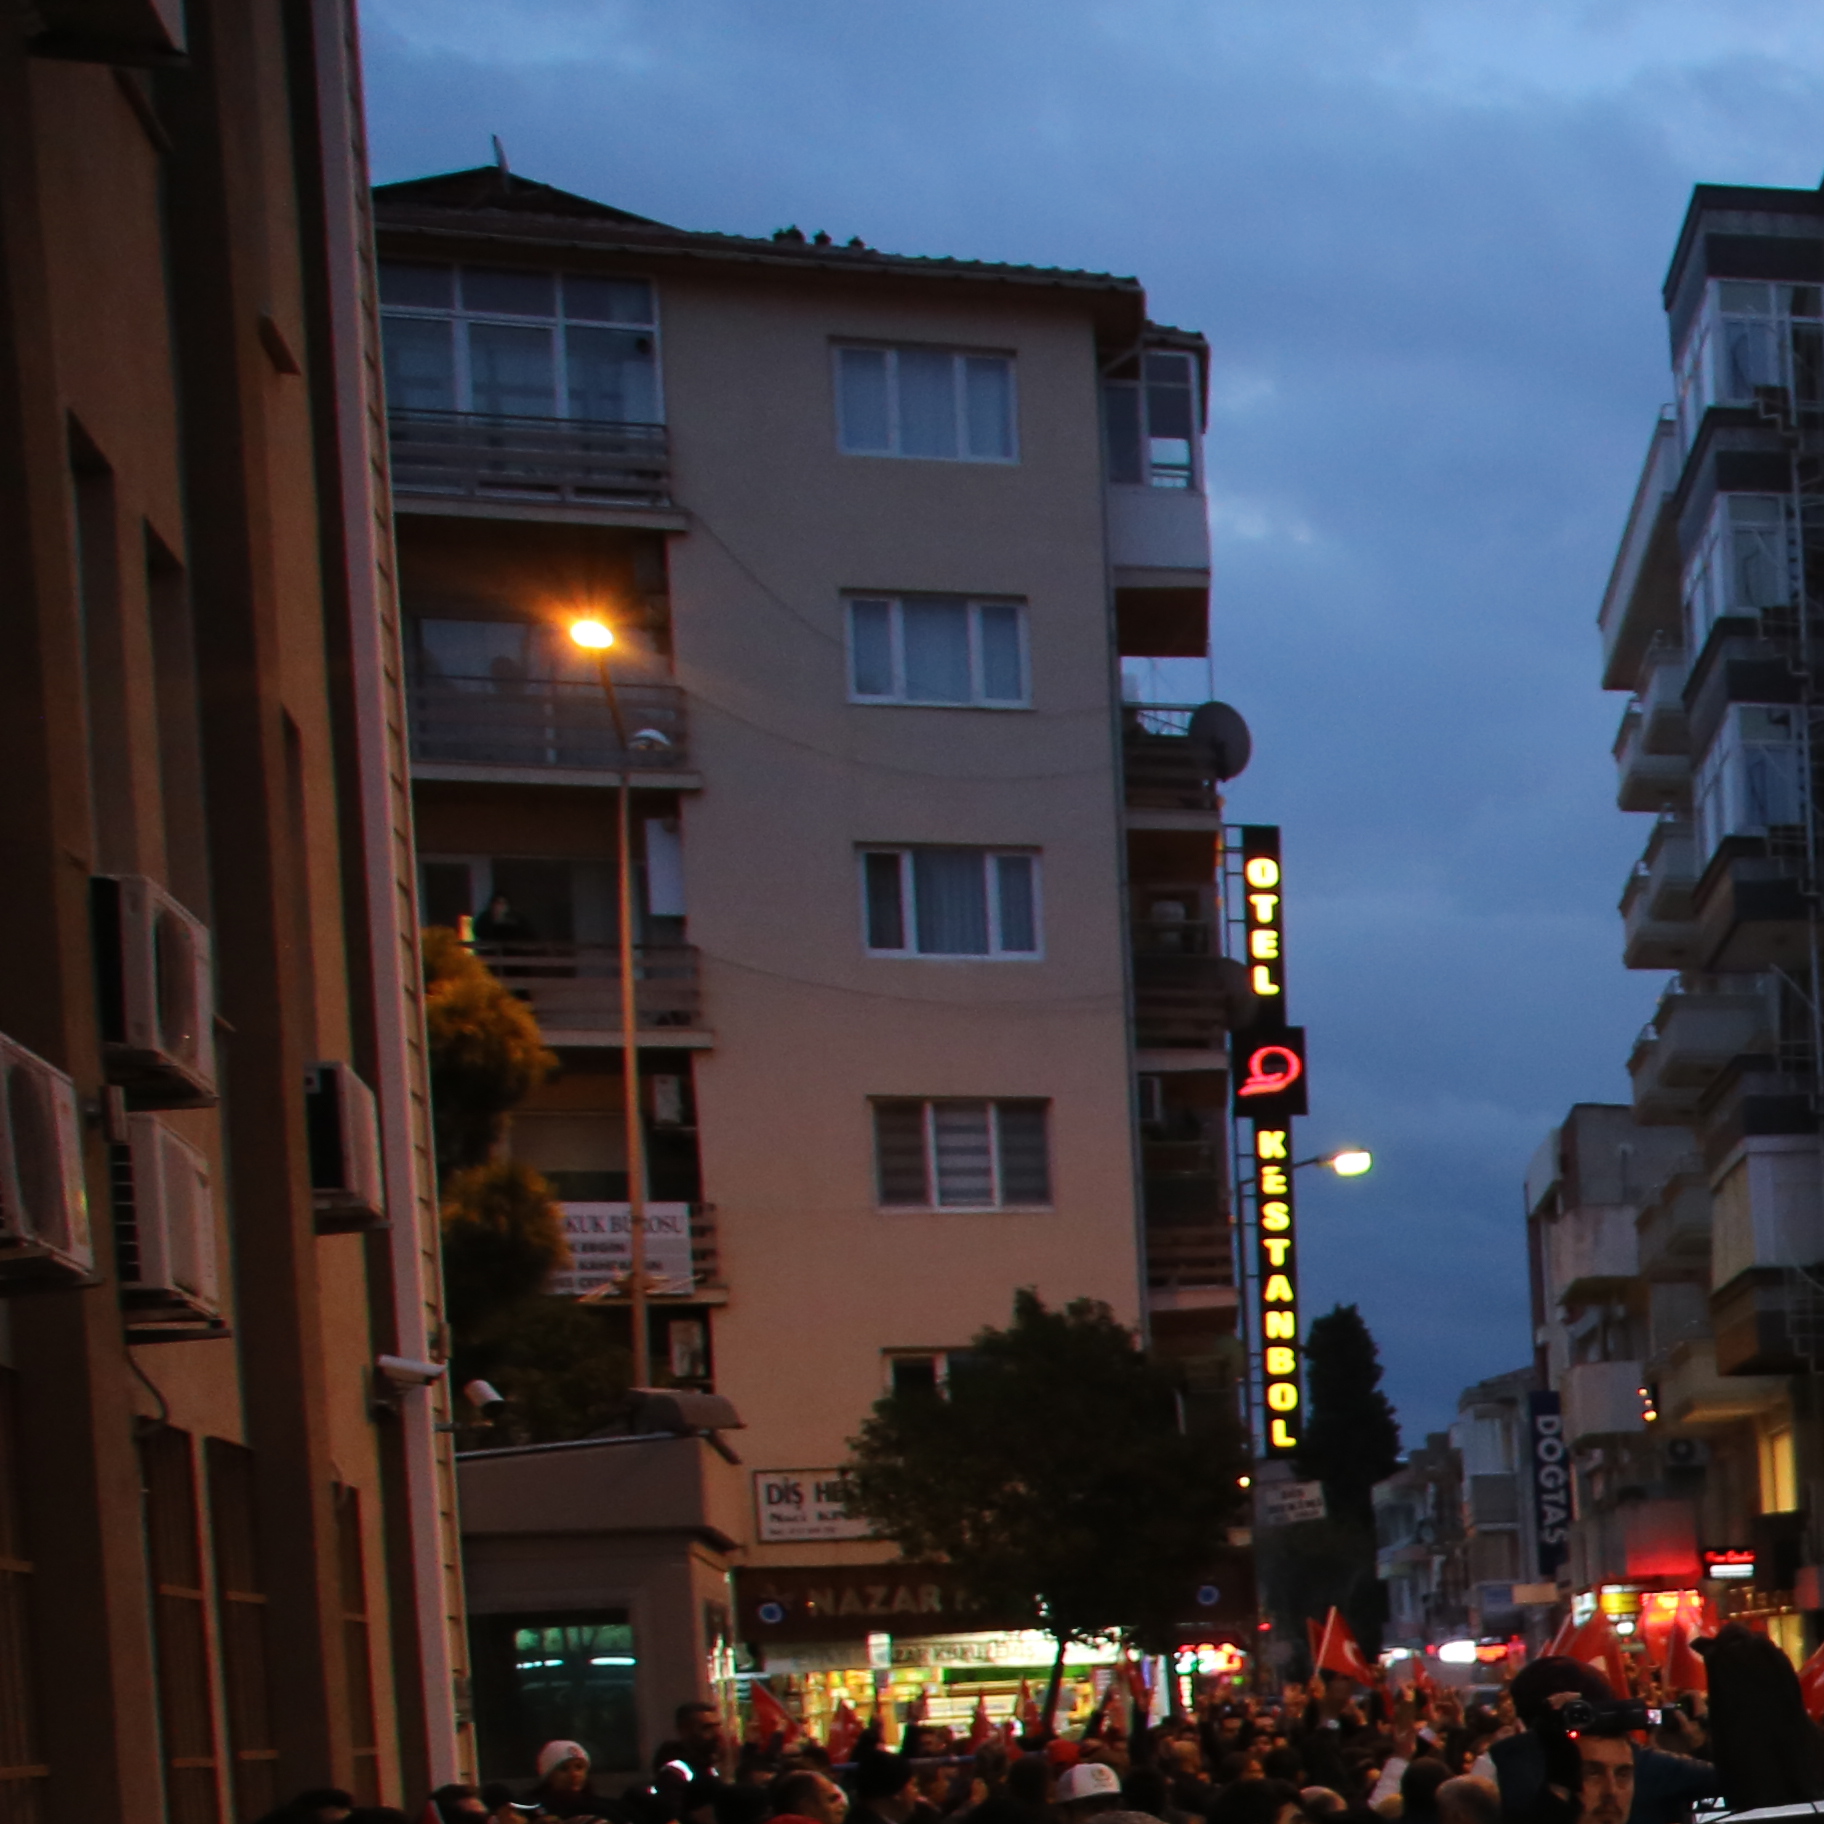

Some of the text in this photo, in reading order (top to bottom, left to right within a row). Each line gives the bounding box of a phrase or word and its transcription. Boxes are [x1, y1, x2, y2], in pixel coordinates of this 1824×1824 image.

[1245, 857, 1281, 995] OTEL
[1257, 1130, 1299, 1448] KESTANBOL
[805, 1584, 942, 1618] NAZAR
